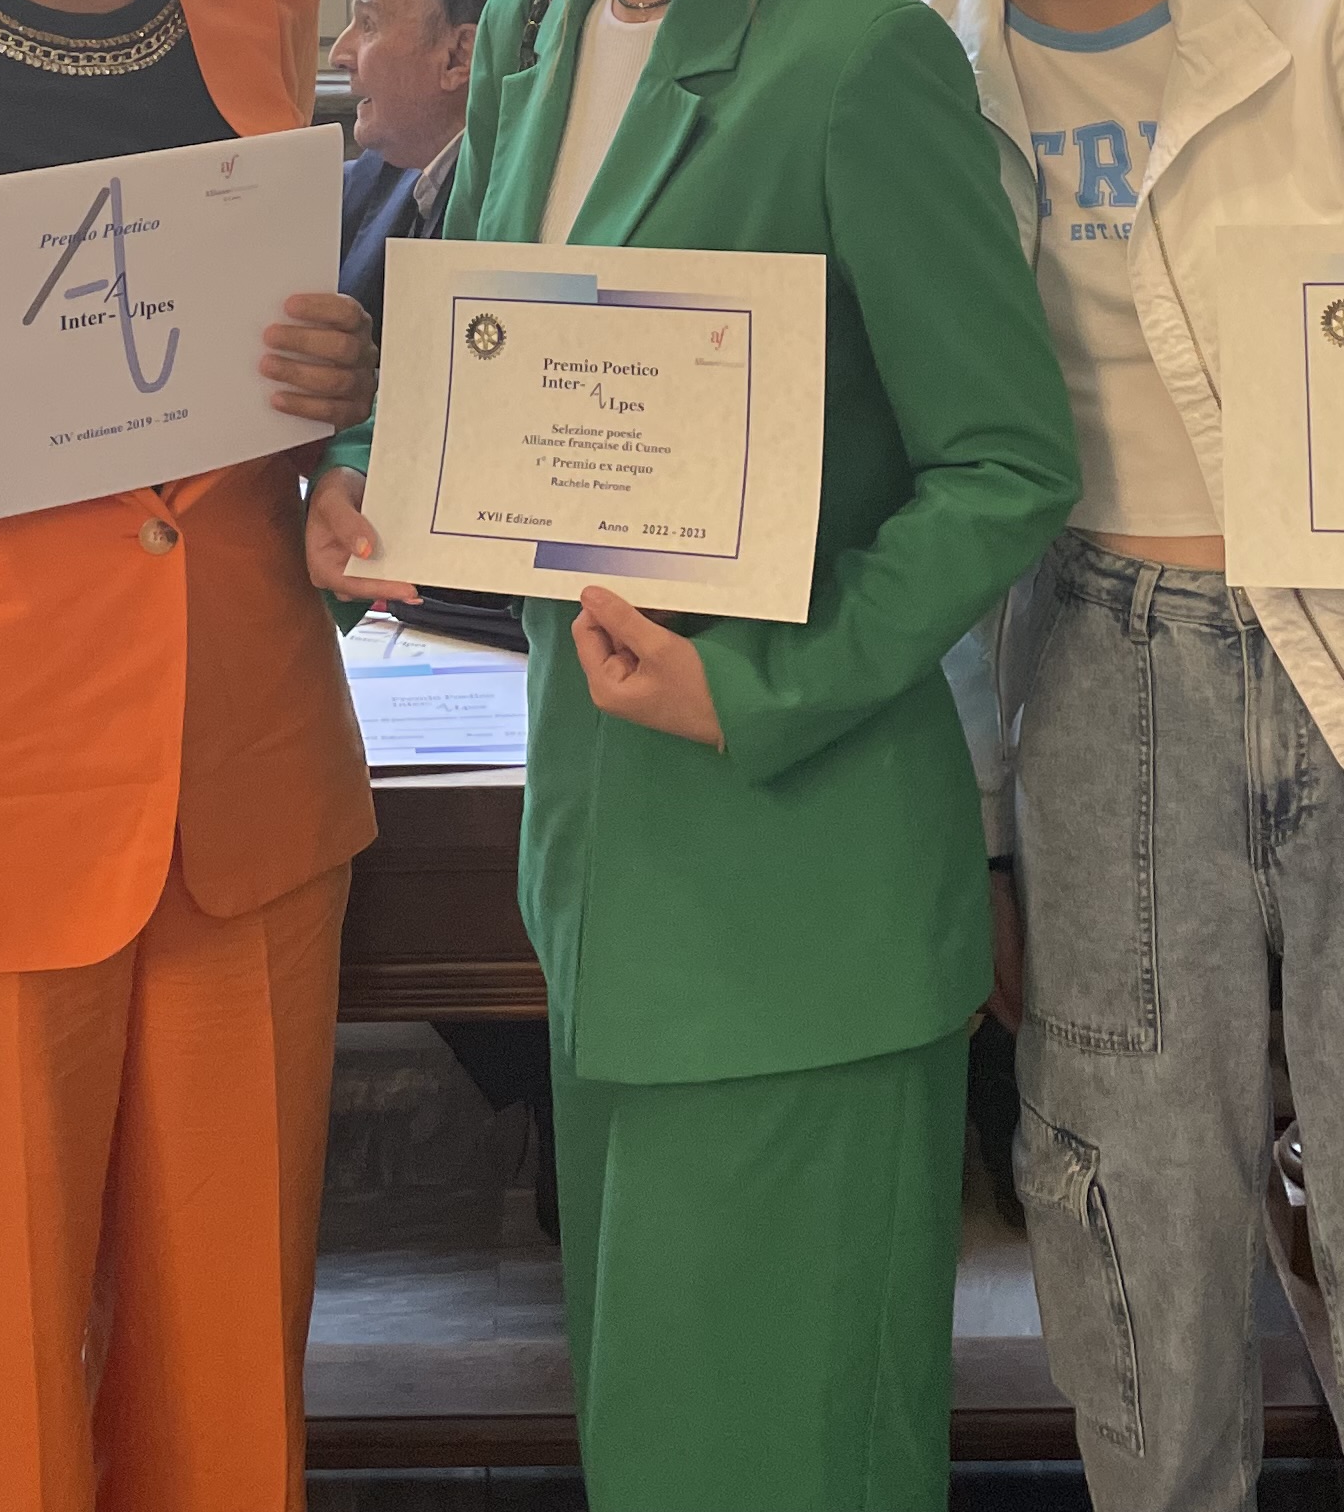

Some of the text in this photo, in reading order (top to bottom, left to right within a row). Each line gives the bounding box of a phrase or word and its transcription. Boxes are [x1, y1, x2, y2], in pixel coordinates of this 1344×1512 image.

[1031, 120, 1158, 219] TR
[103, 217, 160, 239] Poetico
[543, 357, 659, 377] Premio Poetico
[49, 431, 74, 446] XIV
[77, 422, 123, 440] edizione
[126, 417, 152, 431] 2019
[163, 408, 188, 422] 2020
[552, 424, 642, 441] Selezione poesie
[522, 435, 671, 454] Alliance française di Cuneo
[552, 457, 596, 472] Premio
[599, 463, 613, 472] ex
[616, 464, 653, 476] aequo
[476, 511, 552, 527] XVII Edizione
[598, 521, 628, 532] Anno
[642, 524, 669, 536] 2022
[679, 526, 706, 538] 2023
